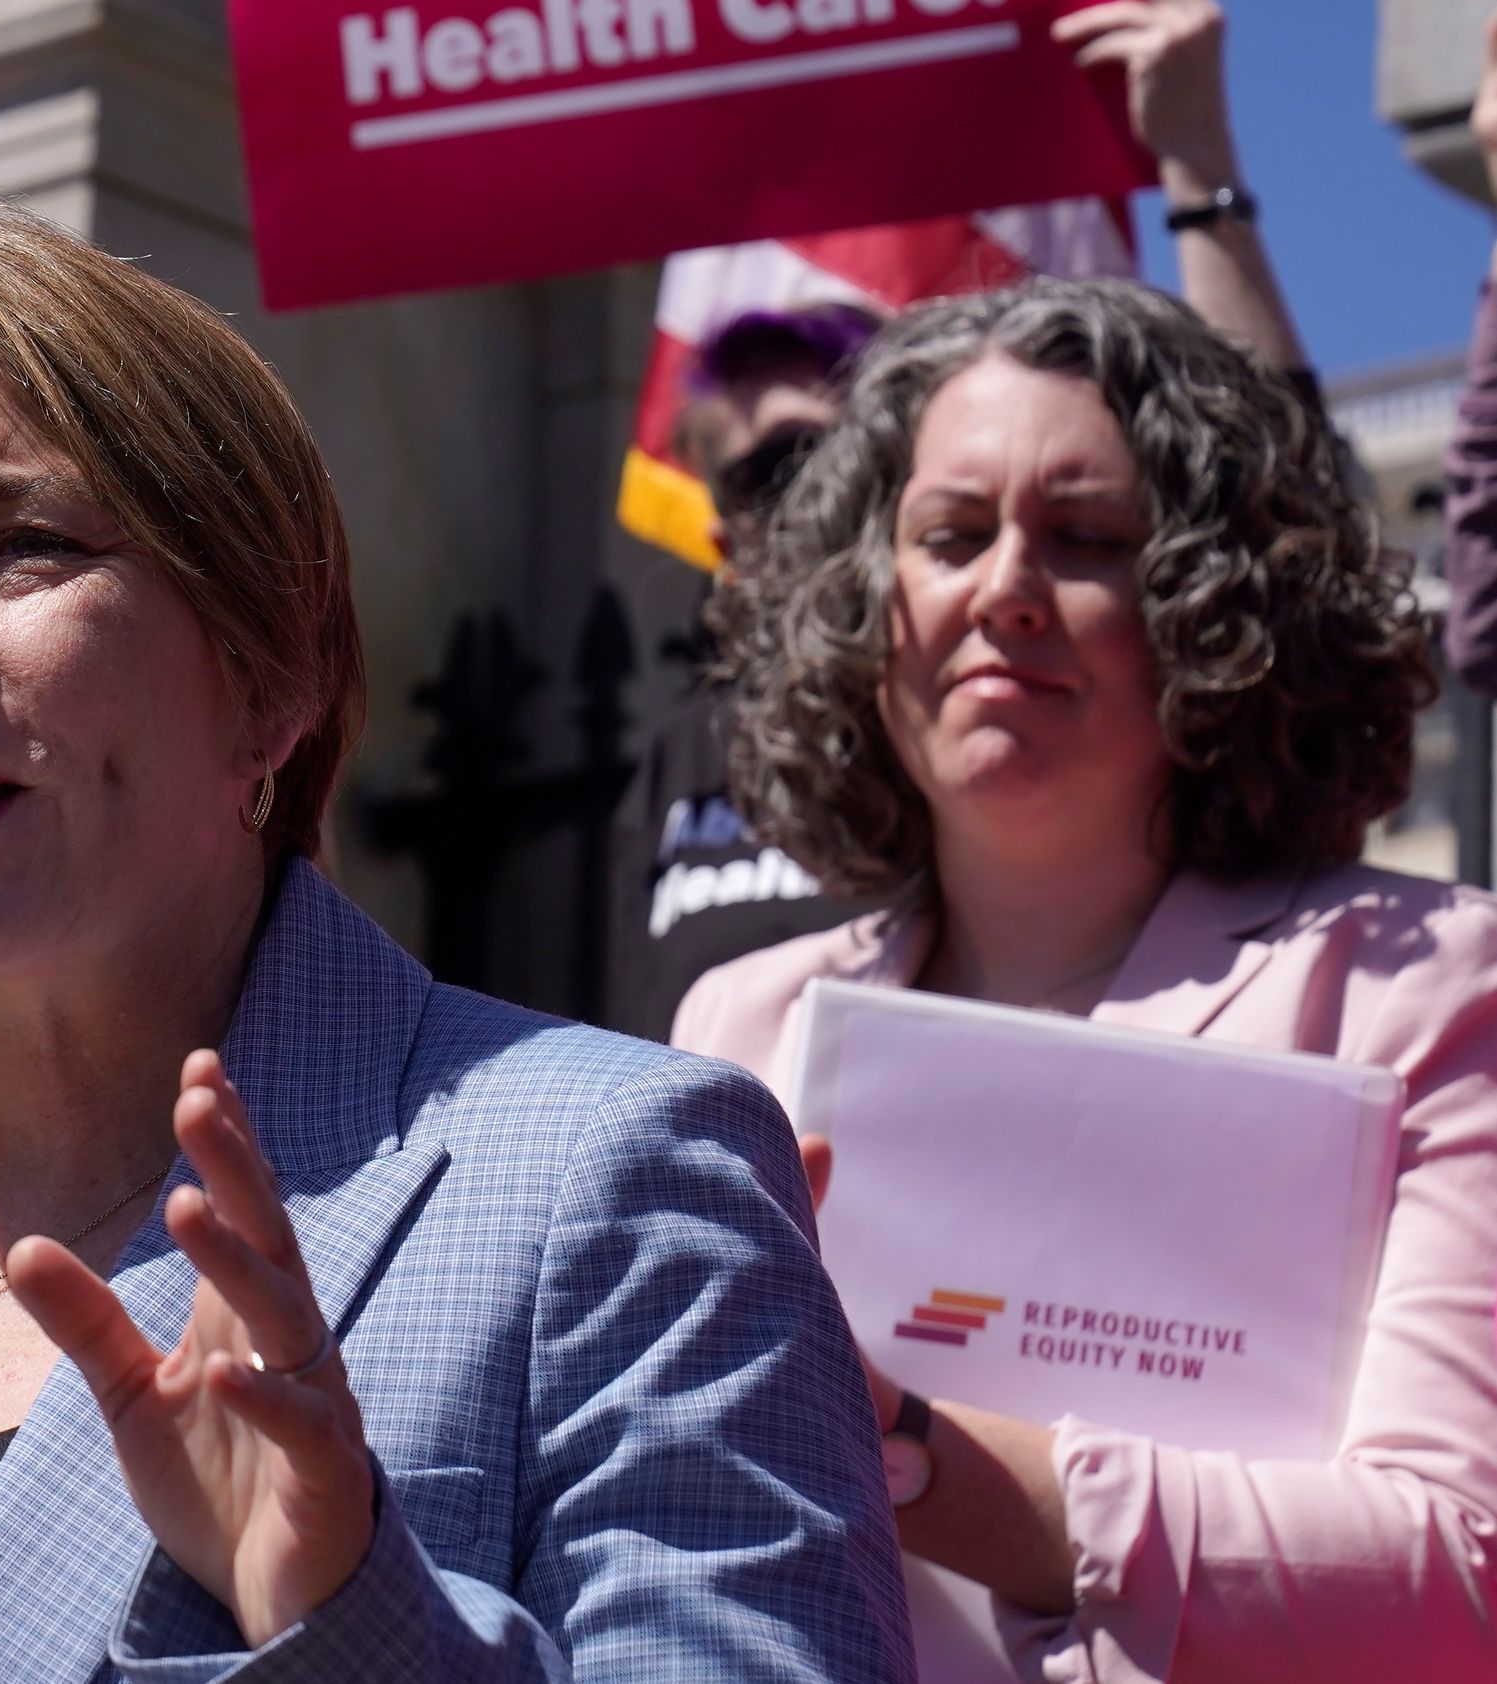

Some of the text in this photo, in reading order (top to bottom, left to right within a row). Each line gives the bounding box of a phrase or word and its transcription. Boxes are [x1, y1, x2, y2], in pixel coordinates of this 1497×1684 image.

[340, 0, 695, 104] Health
[1023, 1300, 1247, 1355] REPRODUCTIVE
[1019, 1333, 1206, 1381] EQUITY NOW
